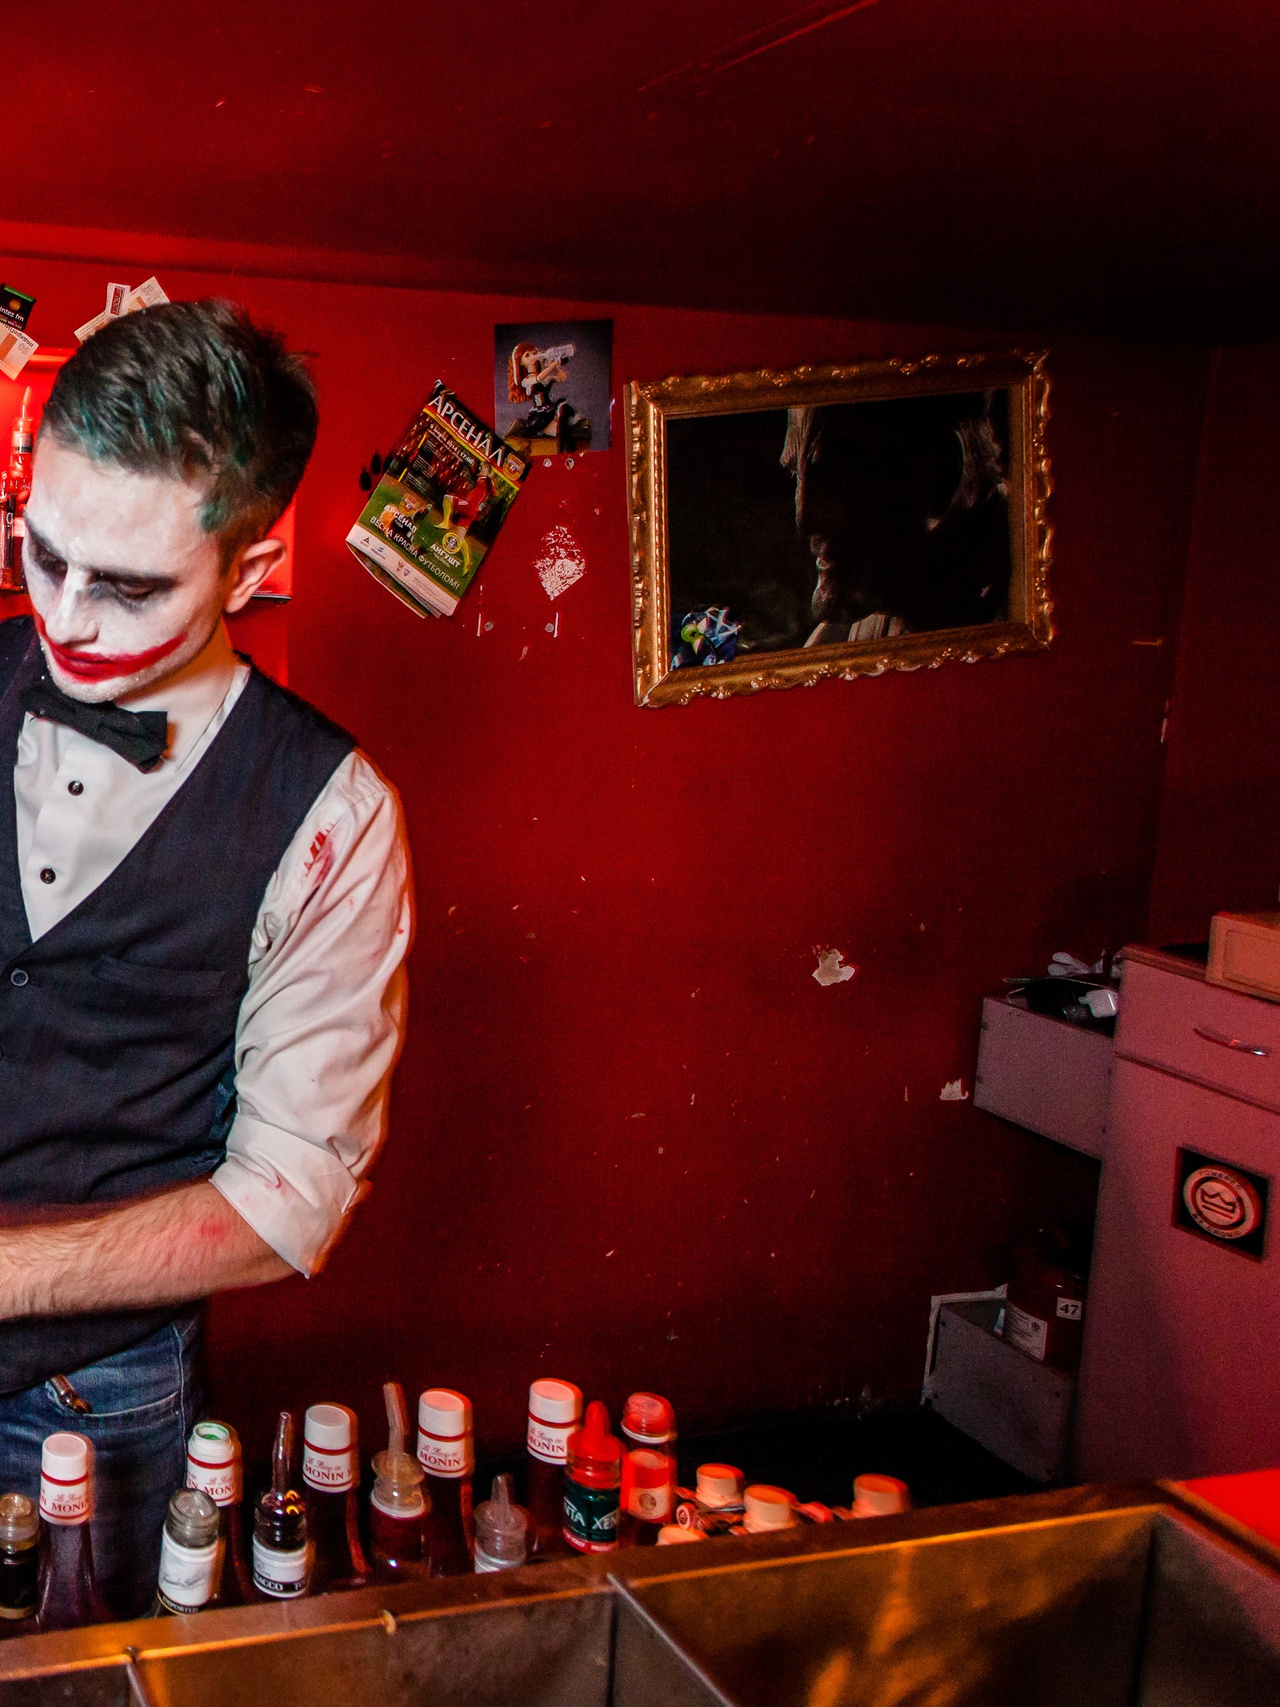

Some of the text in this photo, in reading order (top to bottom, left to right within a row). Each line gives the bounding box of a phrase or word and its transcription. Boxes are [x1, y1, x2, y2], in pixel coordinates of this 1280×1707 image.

[15, 313, 24, 322] fm
[428, 395, 503, 467] АРСЕНАЛ
[384, 505, 417, 533] АРСЕНАЛ
[370, 515, 394, 538] ВЕСНА
[393, 534, 418, 558] КРАСНА
[418, 555, 460, 590] ФУТБОЛОМ!
[431, 543, 461, 568] АНГУШТ
[1059, 1303, 1079, 1316] 47
[419, 1450, 462, 1467] MONIN
[304, 1463, 345, 1482] MONIN
